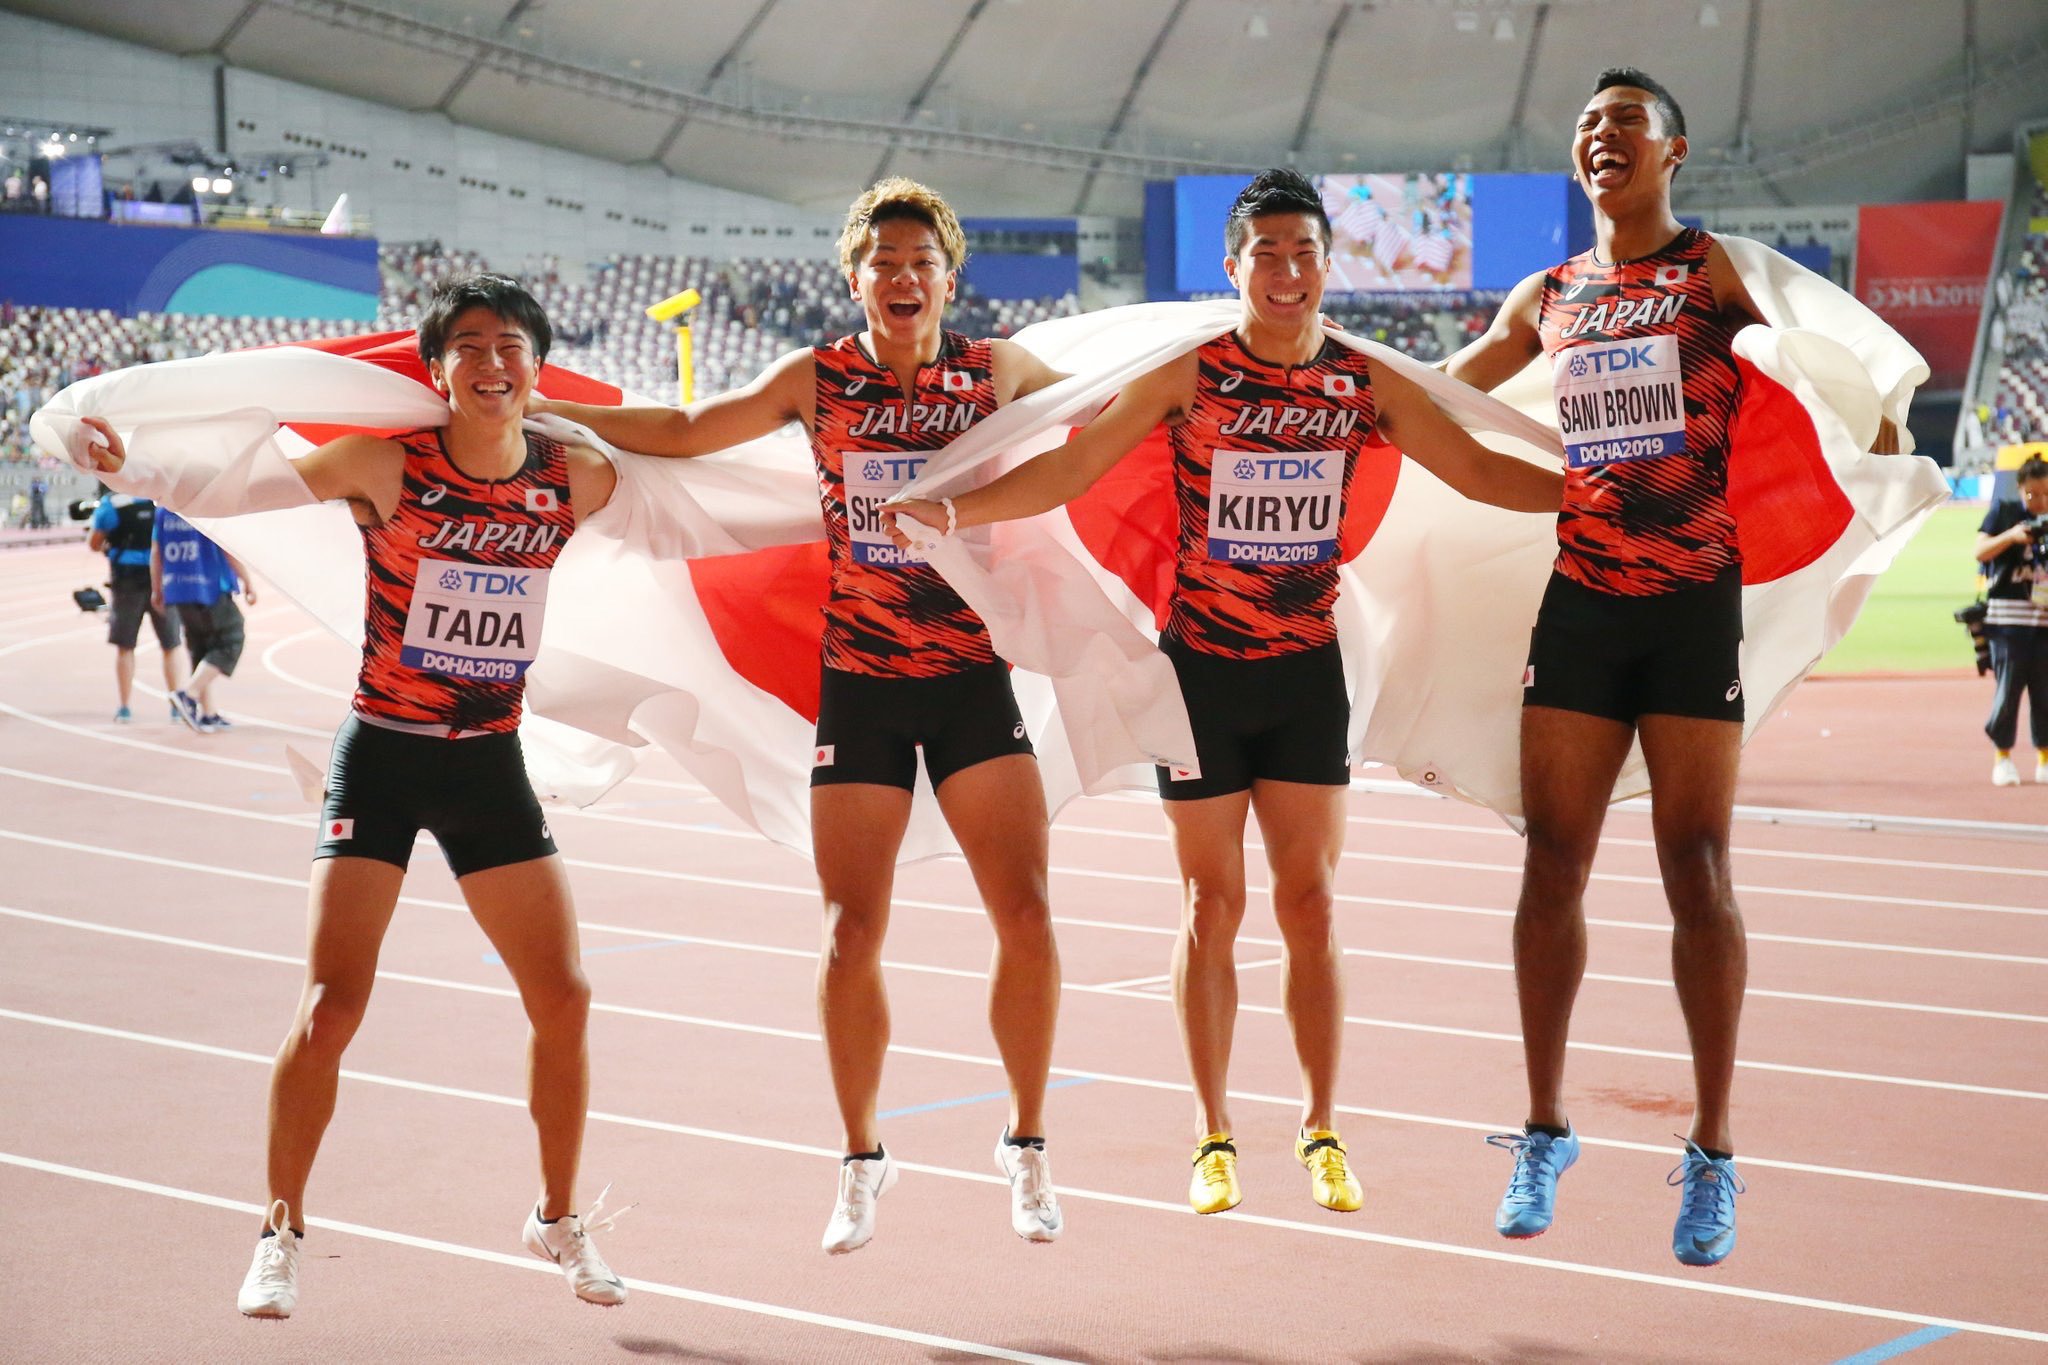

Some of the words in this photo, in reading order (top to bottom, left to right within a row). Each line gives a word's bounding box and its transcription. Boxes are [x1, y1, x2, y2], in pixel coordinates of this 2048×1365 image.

[1560, 294, 1688, 339] JAPAN
[1586, 344, 1657, 374] TDK
[849, 402, 977, 437] JAPAN
[1219, 406, 1360, 438] JAPAN
[1559, 392, 1601, 434] SANI
[1604, 382, 1678, 428] BROWN
[1579, 437, 1664, 464] DOHA2019
[1256, 458, 1327, 480] TDK
[851, 495, 887, 533] SH
[1217, 493, 1331, 532] KIRYU
[418, 520, 561, 553] JAPAN
[1228, 543, 1319, 562] DOHA2019
[463, 570, 531, 596] TDK
[424, 602, 525, 649] TADA
[421, 652, 517, 679] DOHA2019
